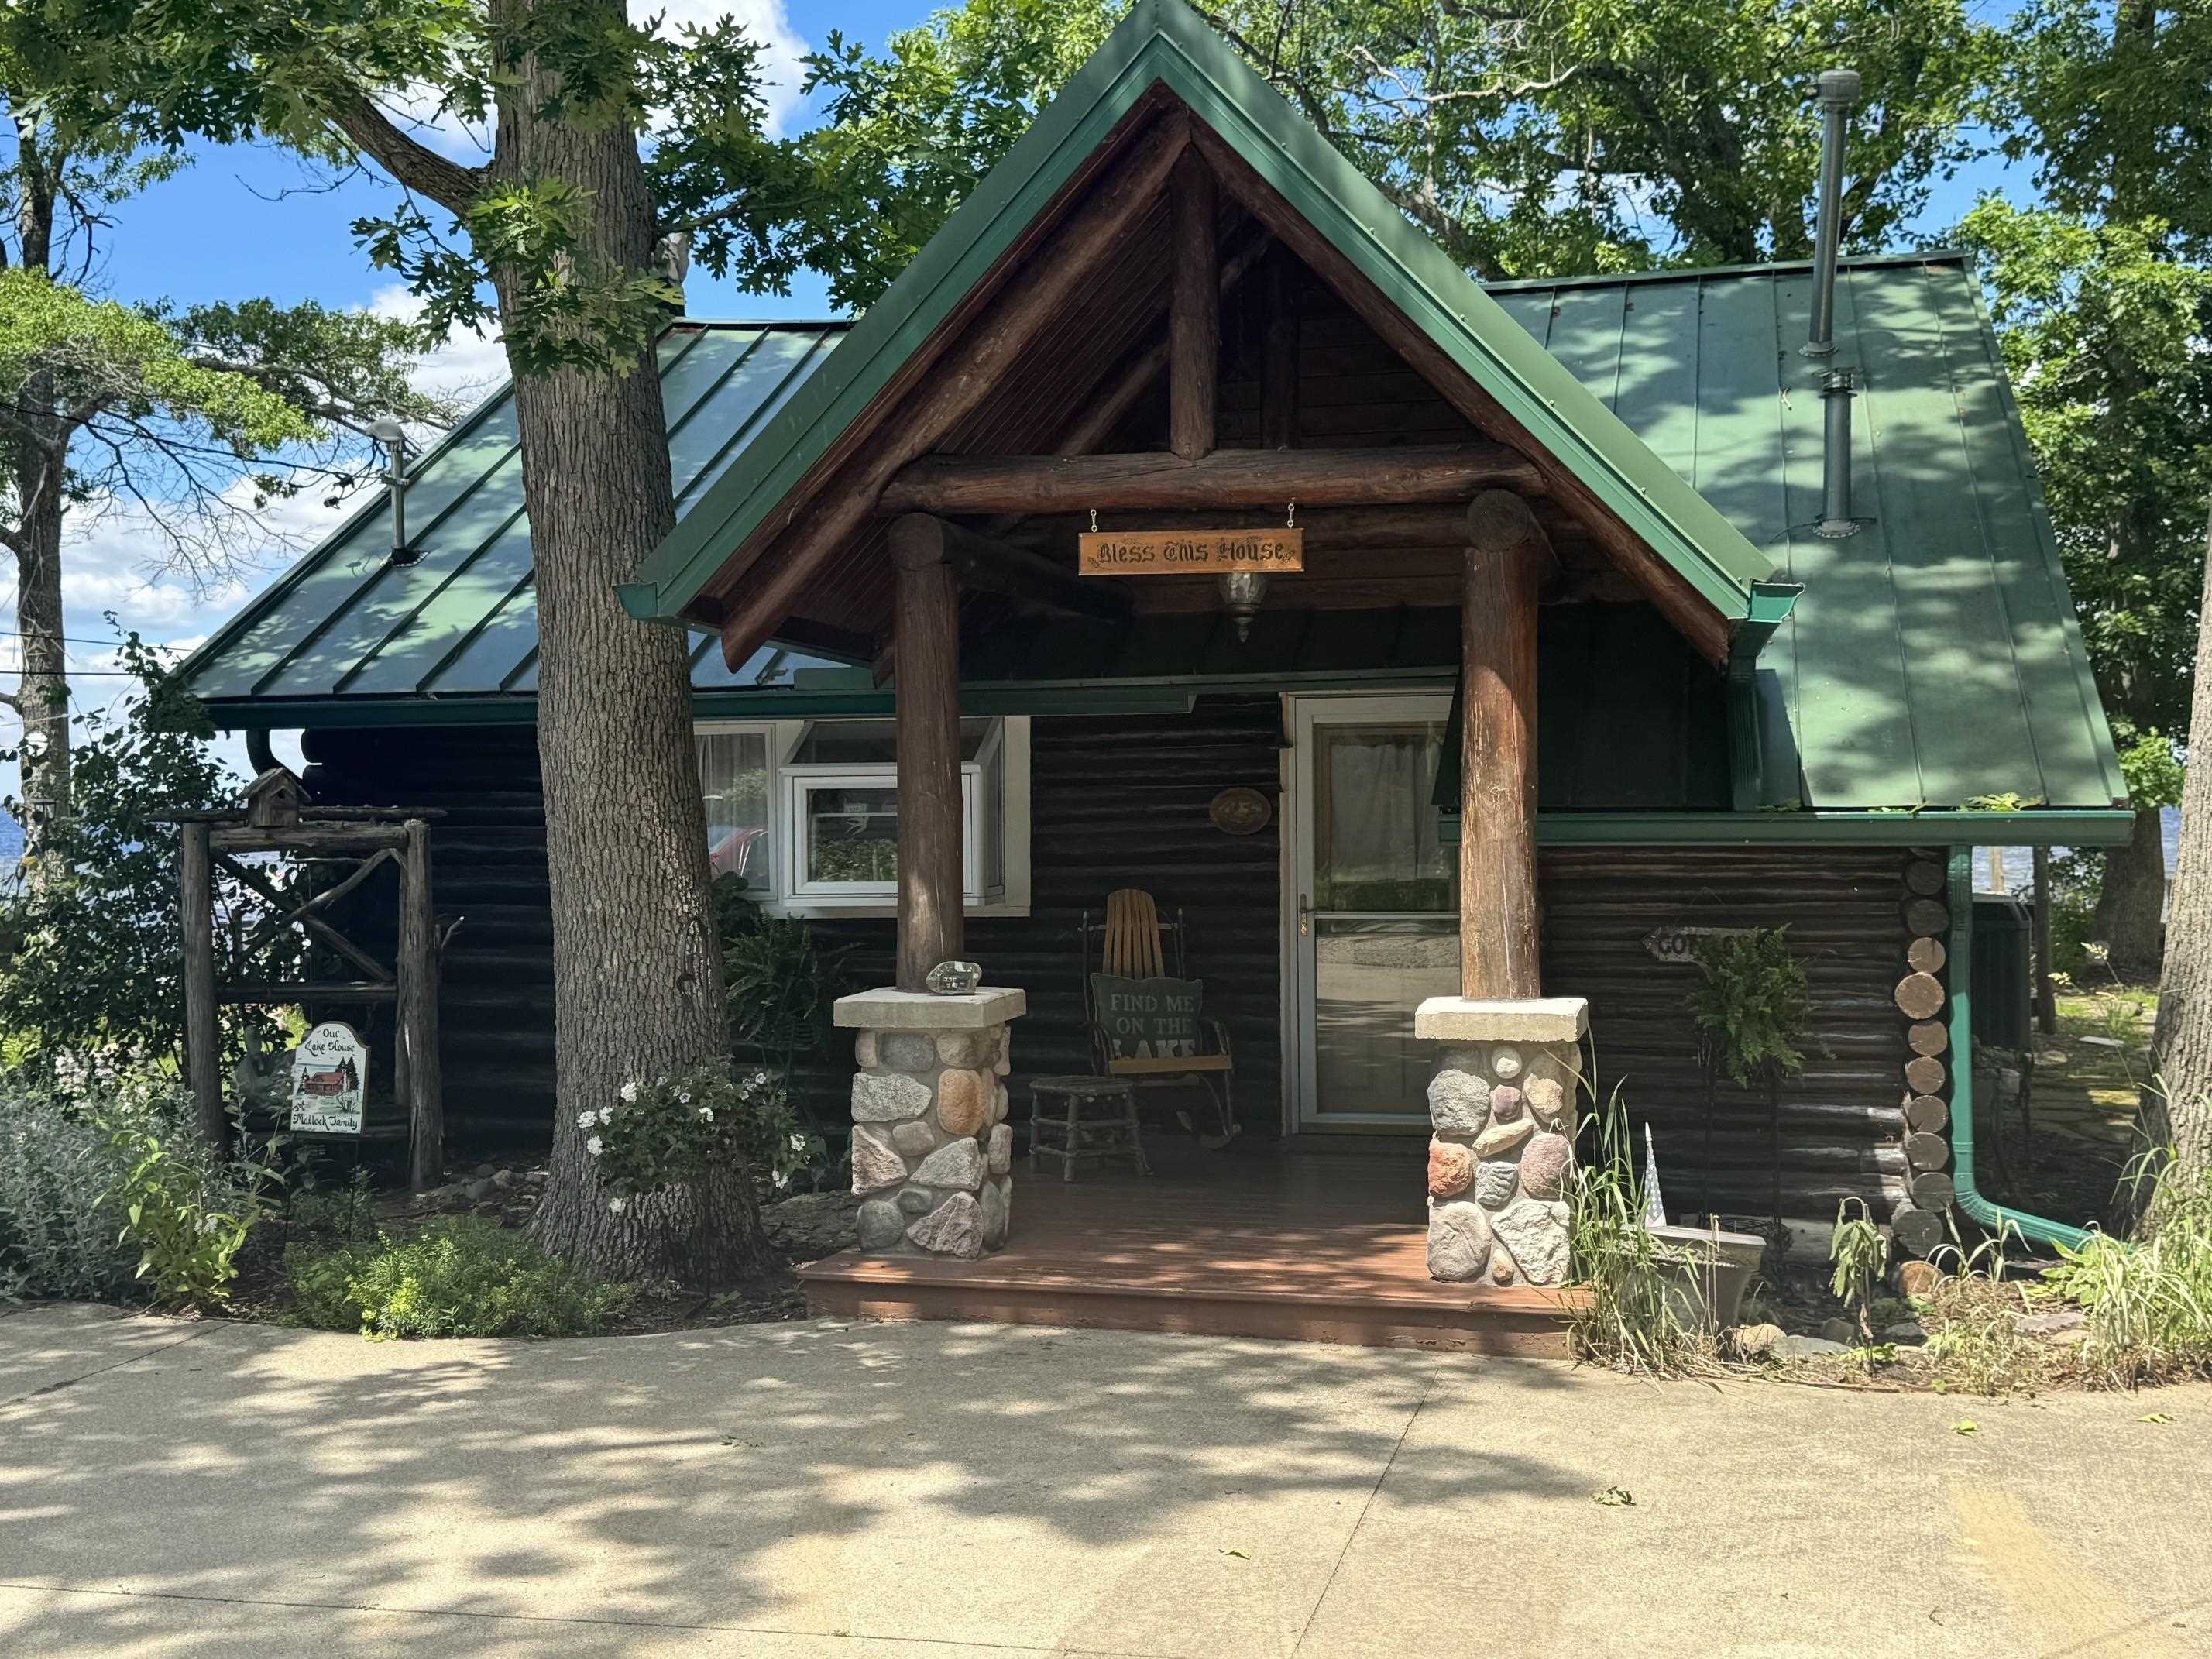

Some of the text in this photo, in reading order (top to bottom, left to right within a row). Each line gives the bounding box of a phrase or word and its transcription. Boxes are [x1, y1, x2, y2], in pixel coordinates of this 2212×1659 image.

[1098, 537, 1285, 564] Bless This House
[1110, 994, 1194, 1012] FIND ME
[322, 1028, 340, 1038] Our
[1115, 1017, 1193, 1035] ON THE
[304, 1040, 355, 1056] Lake House
[1111, 1039, 1195, 1060] LAKE
[328, 1115, 358, 1131] Family
